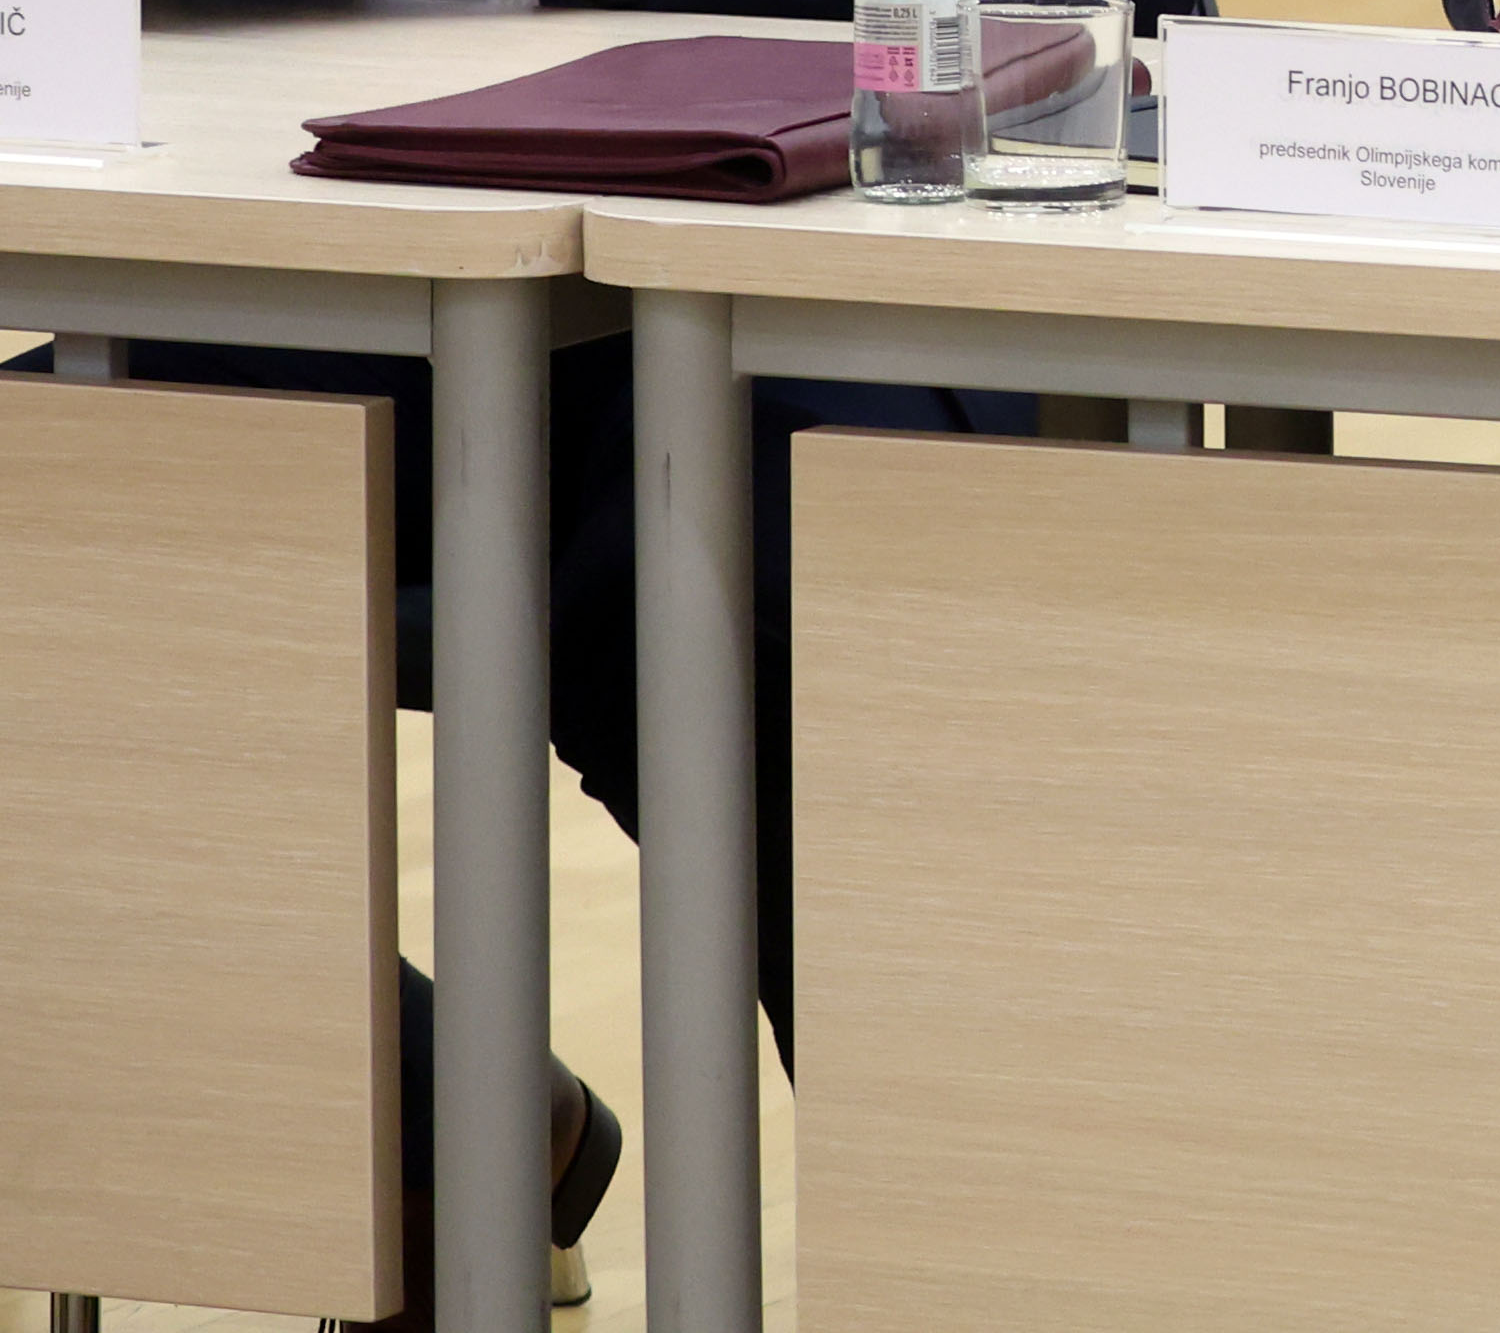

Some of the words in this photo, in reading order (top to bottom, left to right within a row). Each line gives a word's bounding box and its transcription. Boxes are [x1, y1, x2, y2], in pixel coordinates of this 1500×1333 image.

[1287, 70, 1370, 104] Franjo
[1259, 141, 1350, 162] predsednik
[1356, 146, 1463, 173] Olimpijskega
[1360, 170, 1436, 194] Slovenije
